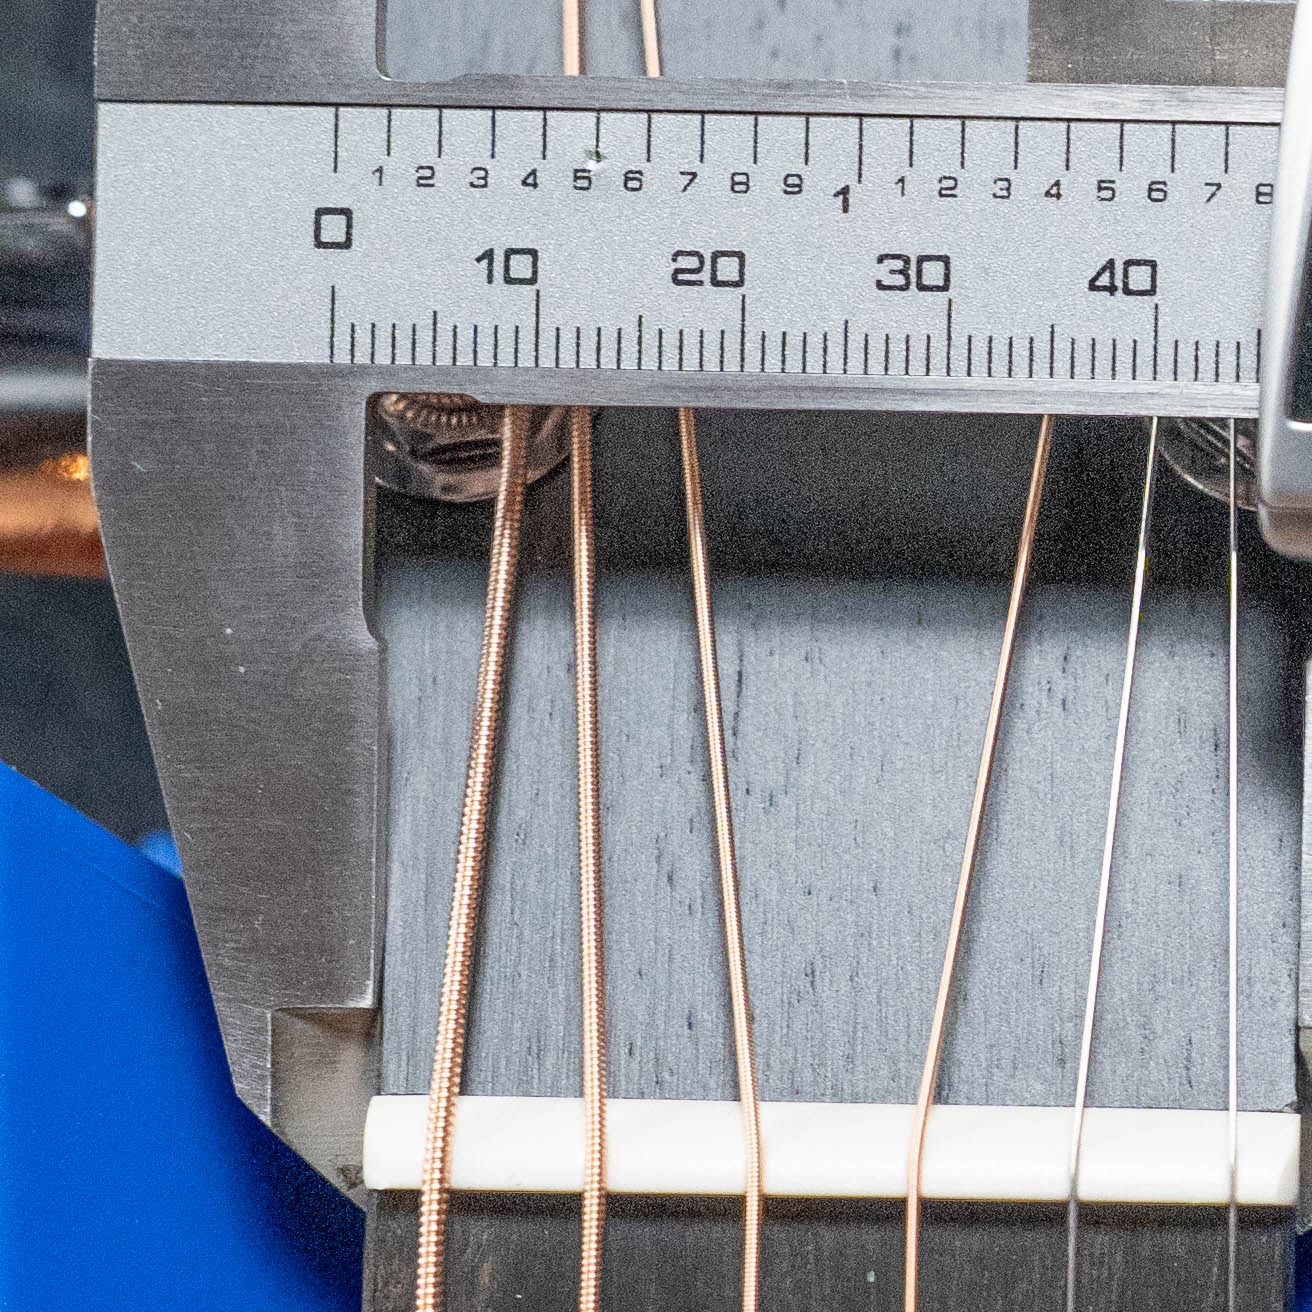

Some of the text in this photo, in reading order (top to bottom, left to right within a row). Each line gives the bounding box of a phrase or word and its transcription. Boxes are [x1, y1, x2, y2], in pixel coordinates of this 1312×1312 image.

[371, 166, 384, 187] 1
[415, 165, 436, 188] 2
[468, 166, 490, 189] 3
[520, 168, 540, 190] 4
[572, 168, 593, 191] 5
[623, 169, 645, 192] 6
[679, 171, 699, 194] 7
[729, 172, 751, 194] 8
[782, 173, 804, 195] 9
[832, 184, 850, 214] 1
[894, 176, 905, 196] 1
[937, 175, 959, 198] 2
[991, 177, 1013, 200] 3
[1043, 179, 1063, 201] 4
[1096, 179, 1117, 202] 5
[1146, 180, 1169, 203] 6
[1203, 182, 1223, 204] 7
[313, 206, 353, 250] 0
[474, 247, 1158, 297] 10 20 30 40
